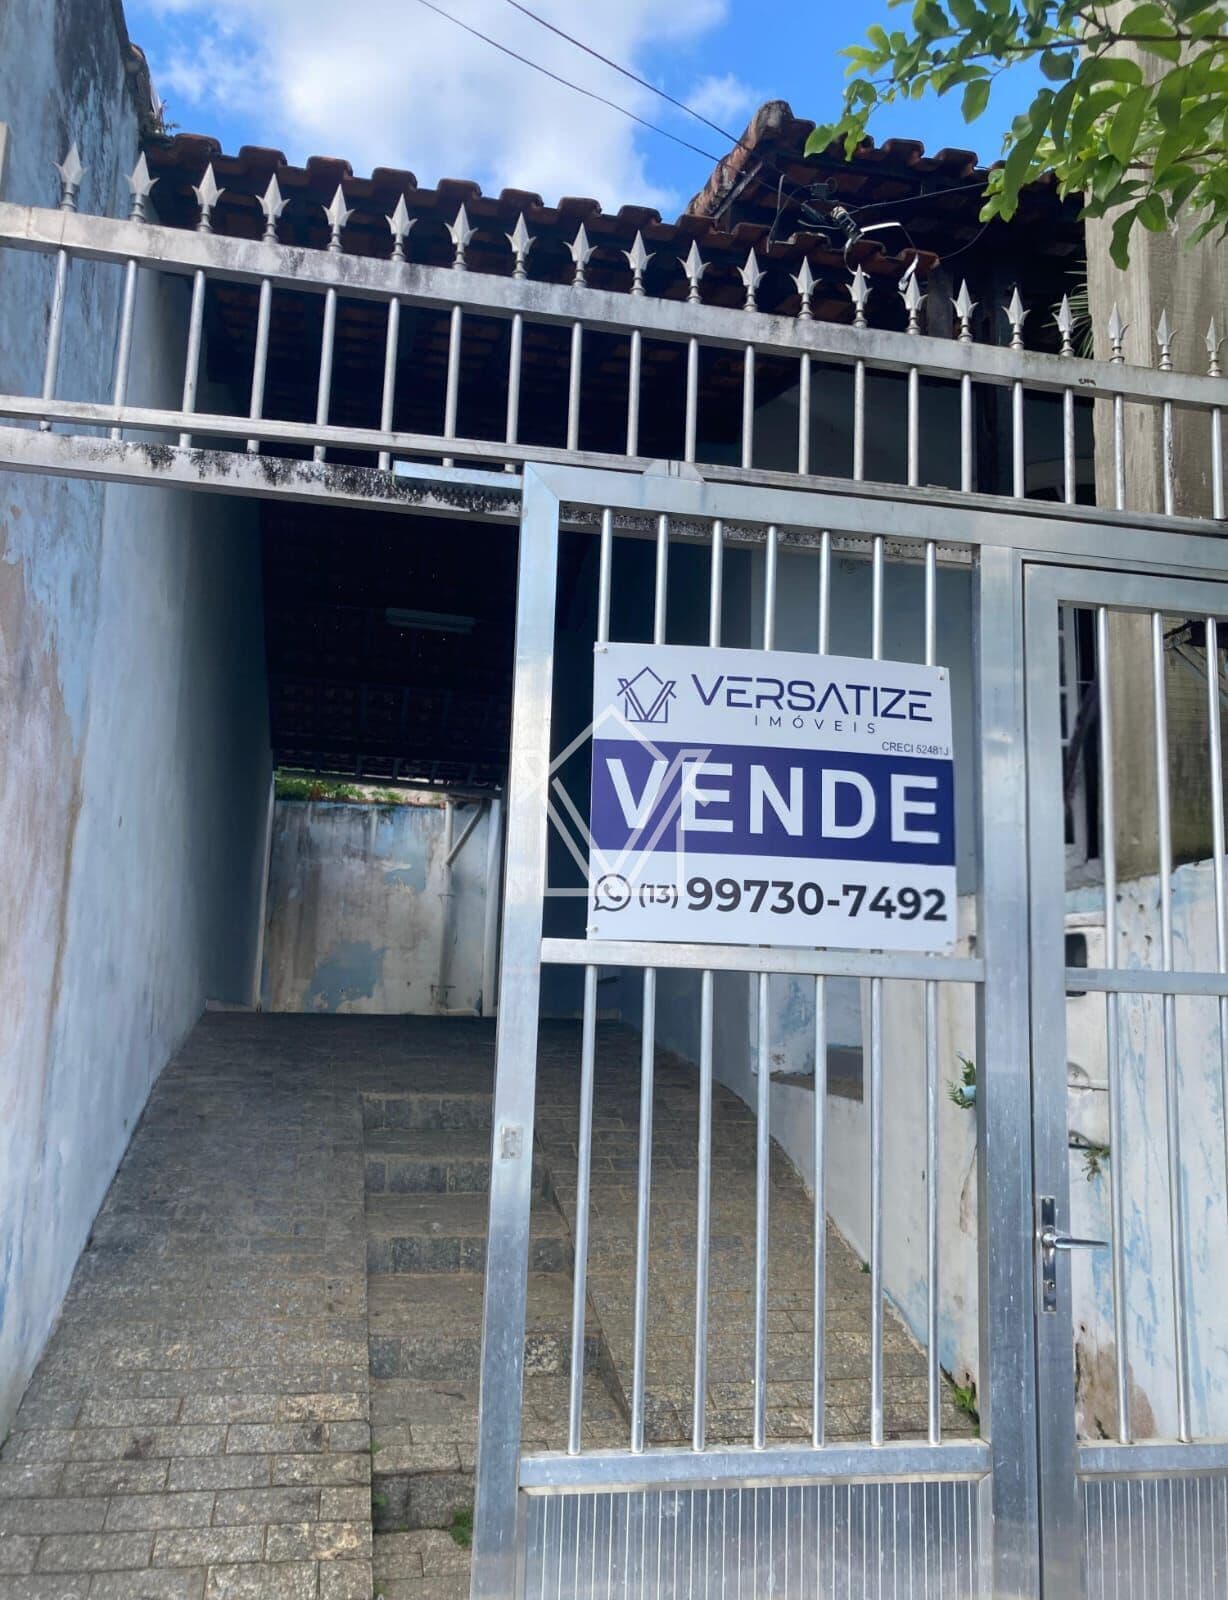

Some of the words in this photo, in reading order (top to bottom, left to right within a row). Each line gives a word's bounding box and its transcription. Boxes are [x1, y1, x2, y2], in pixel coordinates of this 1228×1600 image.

[691, 674, 932, 722] VERSATIZE
[754, 713, 877, 734] IMÓVEIS
[881, 741, 914, 754] CRECI
[606, 758, 940, 844] VENDE
[638, 883, 679, 908] (13)
[686, 876, 947, 922] 99730-7492
